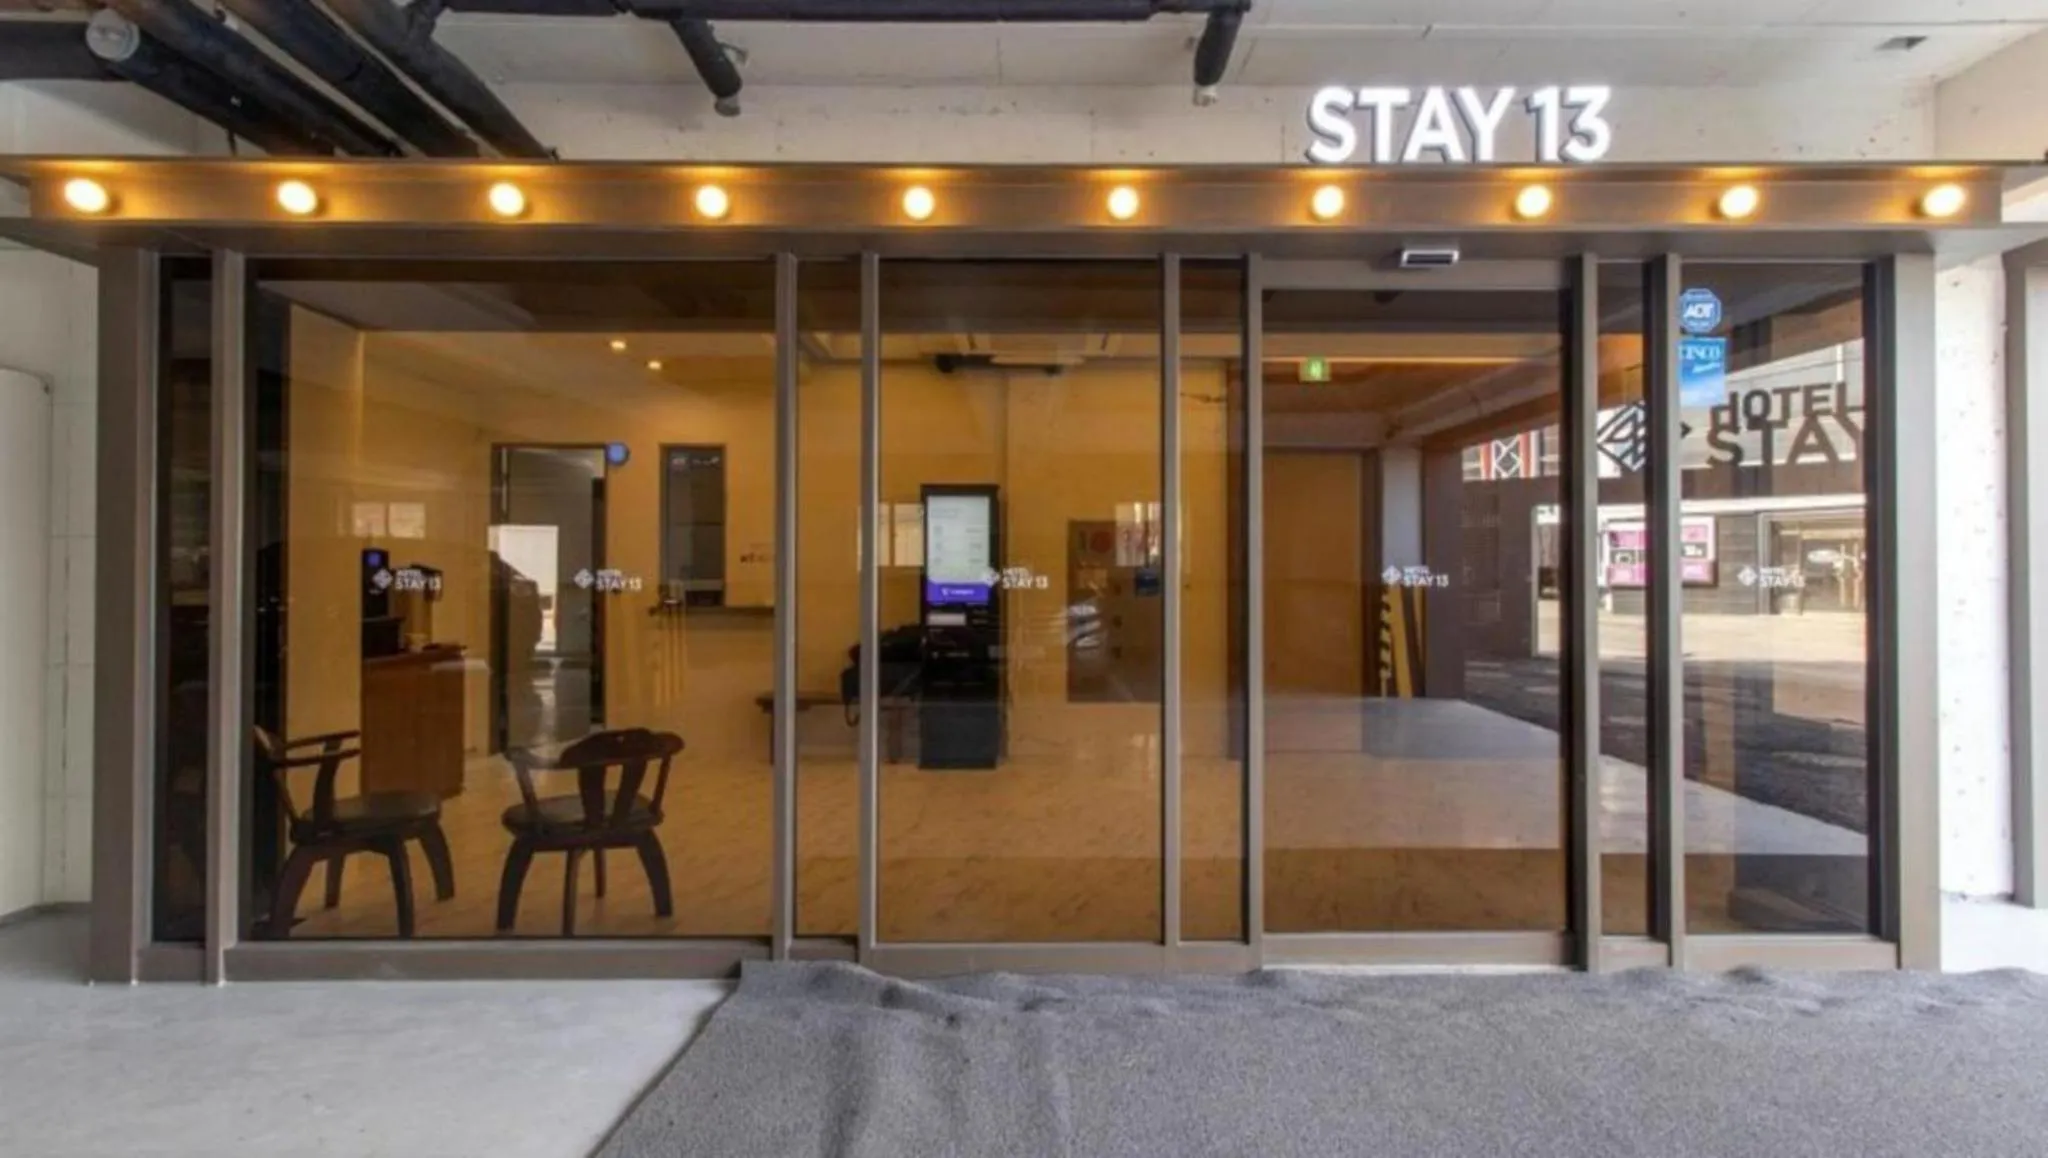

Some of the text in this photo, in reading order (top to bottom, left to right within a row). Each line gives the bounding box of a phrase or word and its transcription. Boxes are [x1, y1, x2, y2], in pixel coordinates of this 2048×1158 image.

[1304, 85, 1612, 163] STAY 13
[395, 576, 442, 590] STAY 13
[596, 577, 643, 591] STAY 13
[1003, 575, 1049, 589] STAY 13
[1403, 574, 1449, 588] STAY 13
[1760, 575, 1790, 588] STAY
